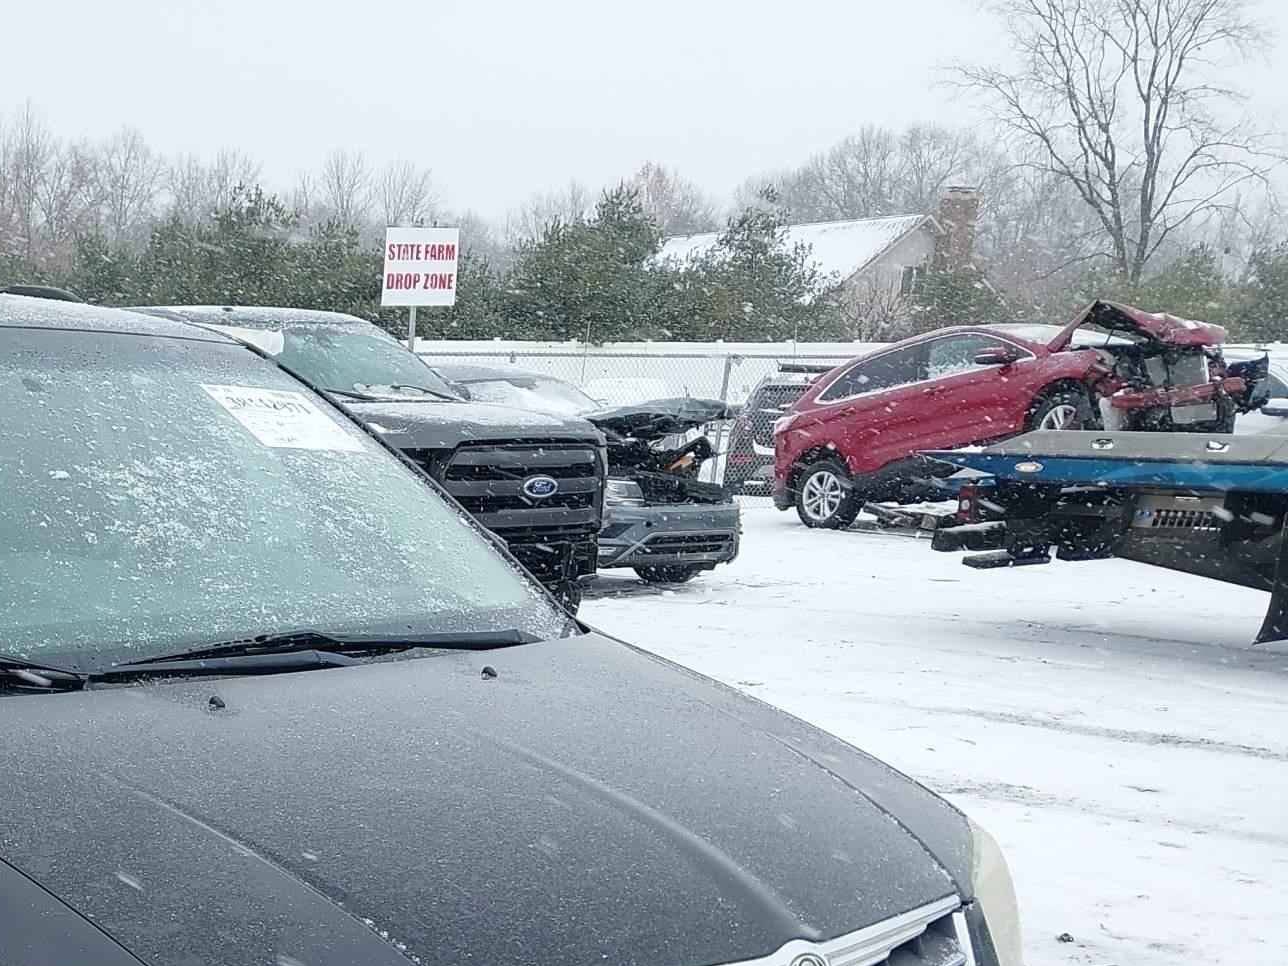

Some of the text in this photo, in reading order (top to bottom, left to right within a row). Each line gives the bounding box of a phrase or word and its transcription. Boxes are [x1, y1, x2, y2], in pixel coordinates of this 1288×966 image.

[388, 243, 456, 261] STATE FARM
[386, 273, 453, 290] DROP ZONE
